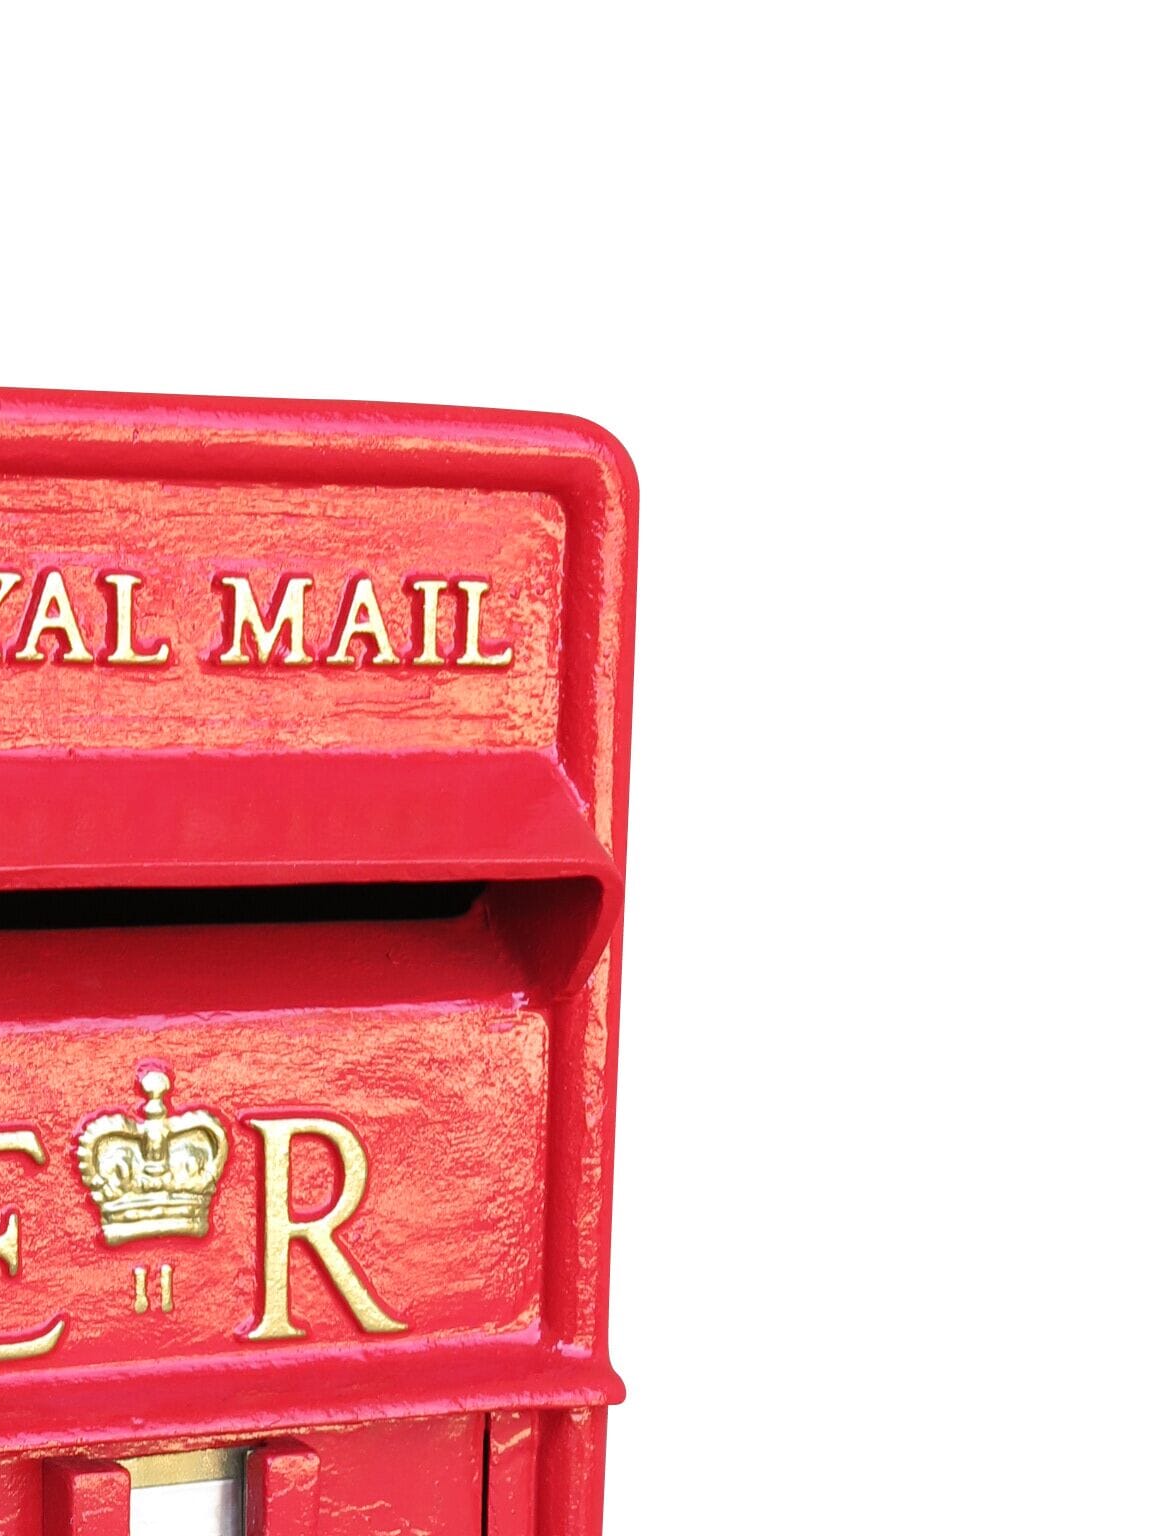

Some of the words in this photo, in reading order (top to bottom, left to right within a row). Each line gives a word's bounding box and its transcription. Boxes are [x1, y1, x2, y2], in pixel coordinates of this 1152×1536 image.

[219, 576, 514, 667] MAIL
[248, 1117, 409, 1340] R
[132, 1263, 174, 1314] II
